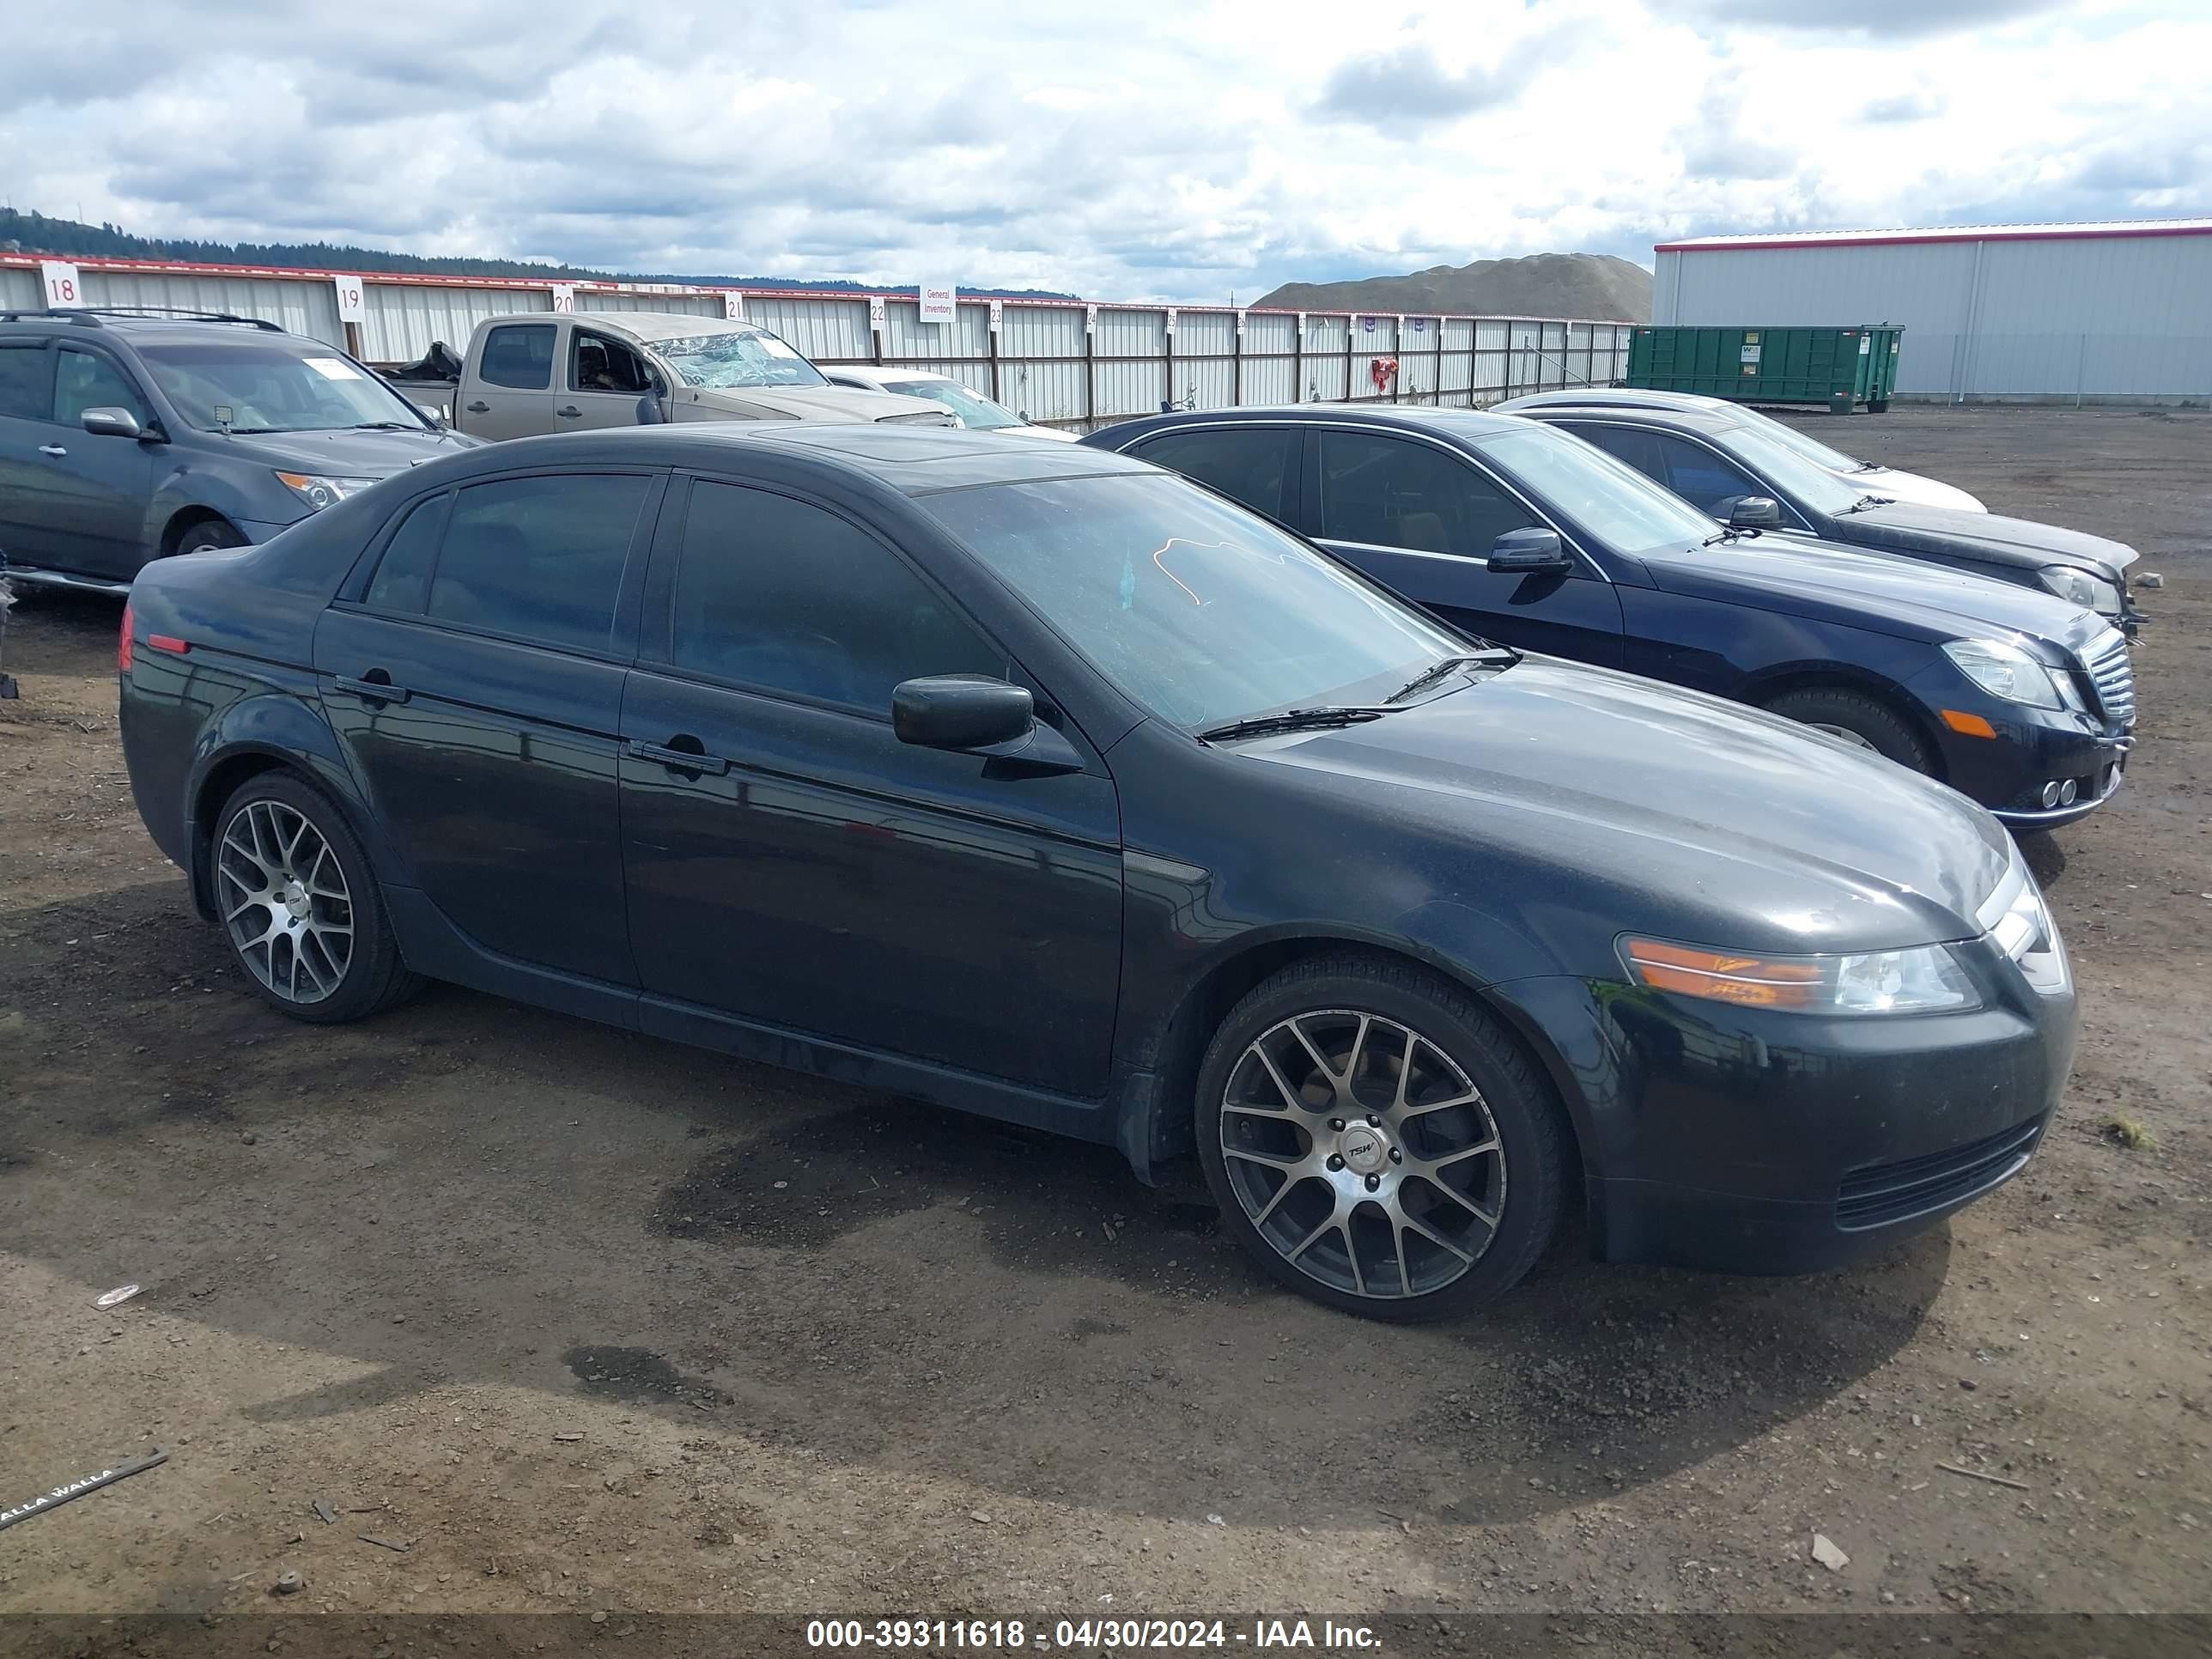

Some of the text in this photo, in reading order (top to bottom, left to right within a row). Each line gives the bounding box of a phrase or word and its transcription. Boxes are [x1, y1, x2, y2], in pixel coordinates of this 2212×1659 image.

[52, 279, 74, 301] 18
[927, 289, 950, 300] General
[342, 289, 358, 308] 19
[555, 296, 573, 313] 20
[728, 301, 740, 318] 21
[872, 306, 884, 320] 22
[924, 303, 952, 315] Inventory
[991, 309, 1001, 323] 23
[1088, 312, 1096, 325] 24
[1168, 314, 1176, 326] 25
[1237, 317, 1245, 328] 26
[1348, 1142, 1375, 1158] TSW
[51, 1469, 112, 1498] WALLA
